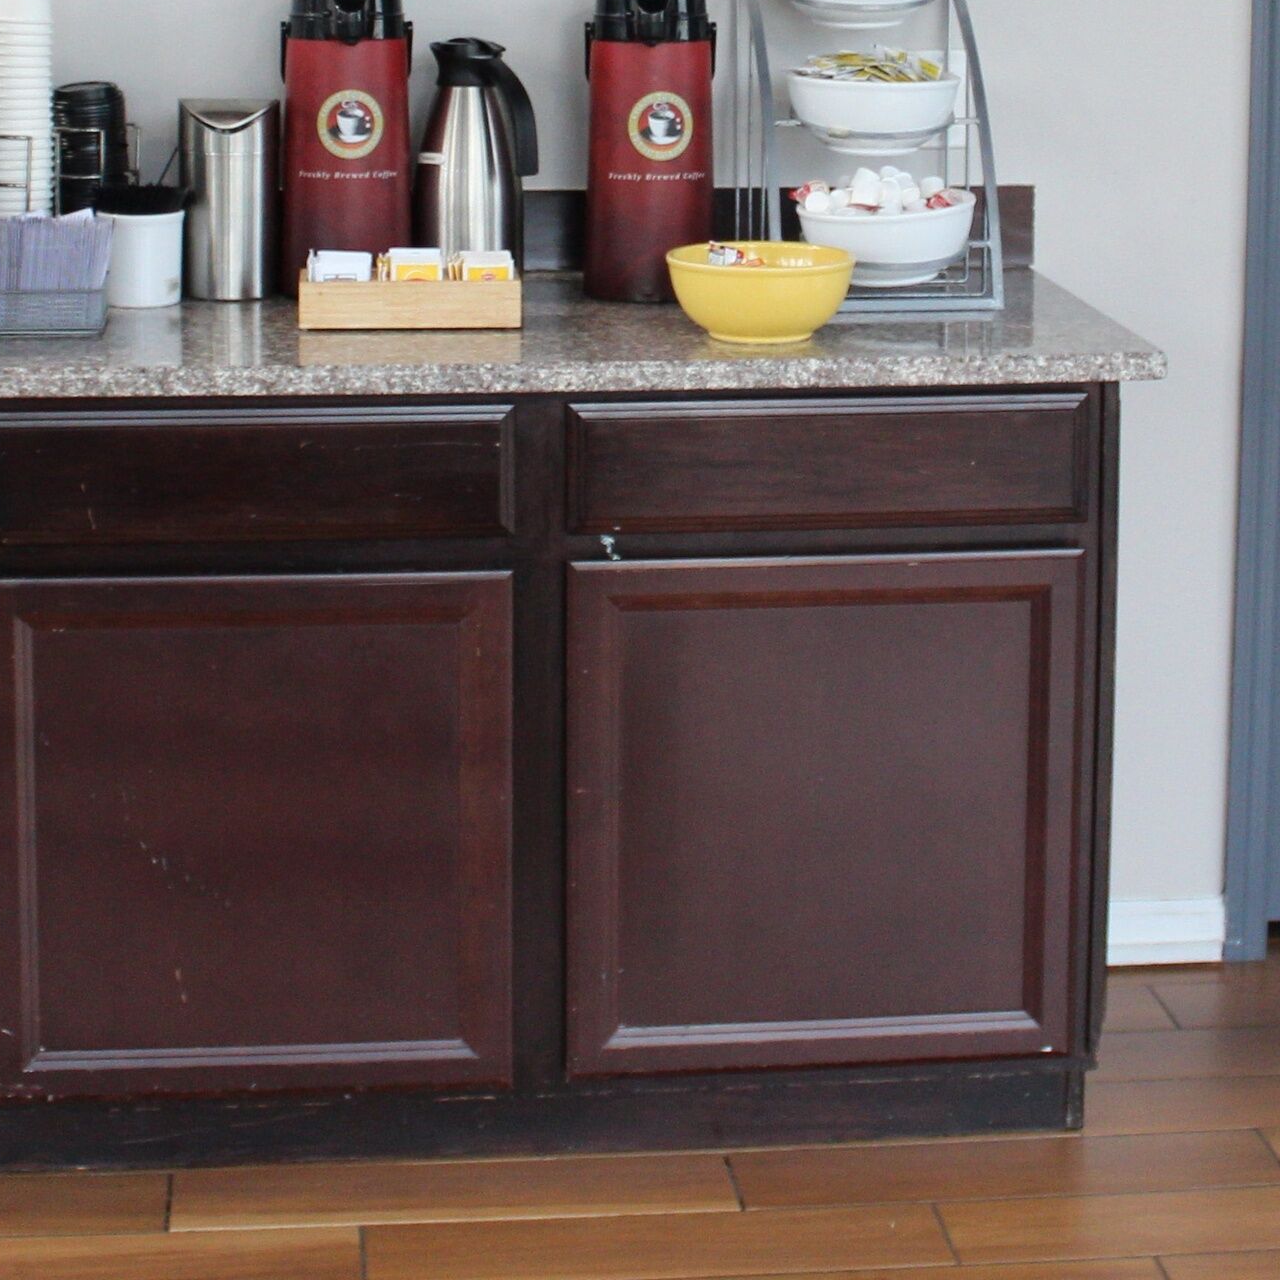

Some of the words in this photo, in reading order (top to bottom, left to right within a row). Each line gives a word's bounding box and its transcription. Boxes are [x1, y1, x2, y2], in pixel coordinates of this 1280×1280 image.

[298, 170, 331, 180] Freshly
[334, 170, 370, 179] Brewed
[372, 170, 398, 179] Coffee
[608, 172, 642, 182] Freshly
[646, 172, 681, 181] Brewed
